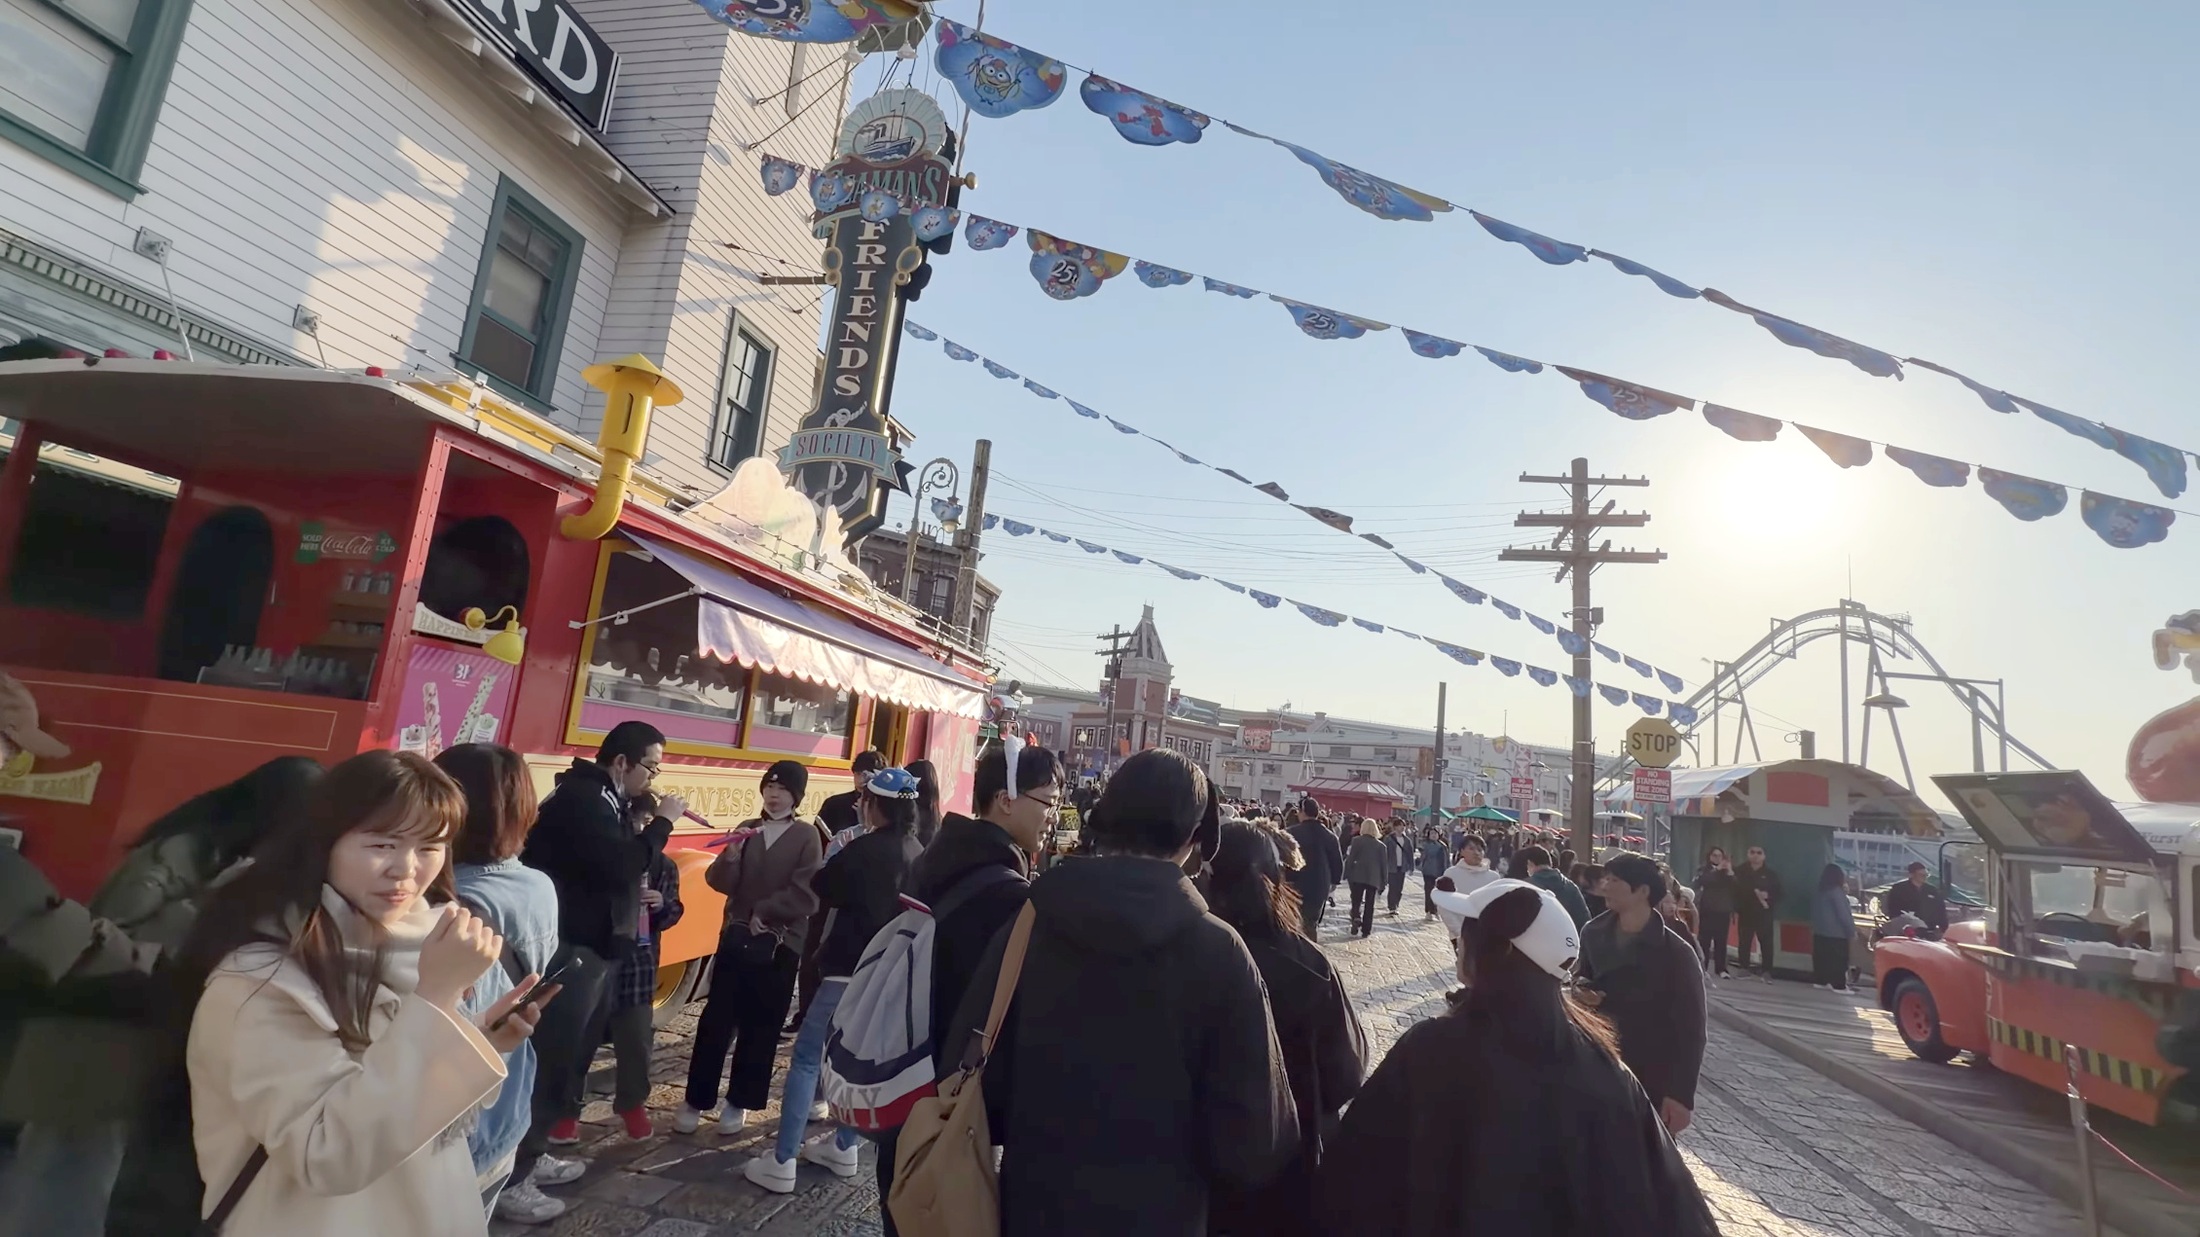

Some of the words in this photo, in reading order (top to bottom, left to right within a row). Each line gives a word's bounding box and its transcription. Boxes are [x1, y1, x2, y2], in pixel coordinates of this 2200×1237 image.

[833, 165, 942, 206] AMAN'S
[832, 218, 891, 396] FRIENDS
[1632, 732, 1677, 753] STOP
[1636, 777, 1670, 787] STANDING
[1647, 770, 1659, 778] NO
